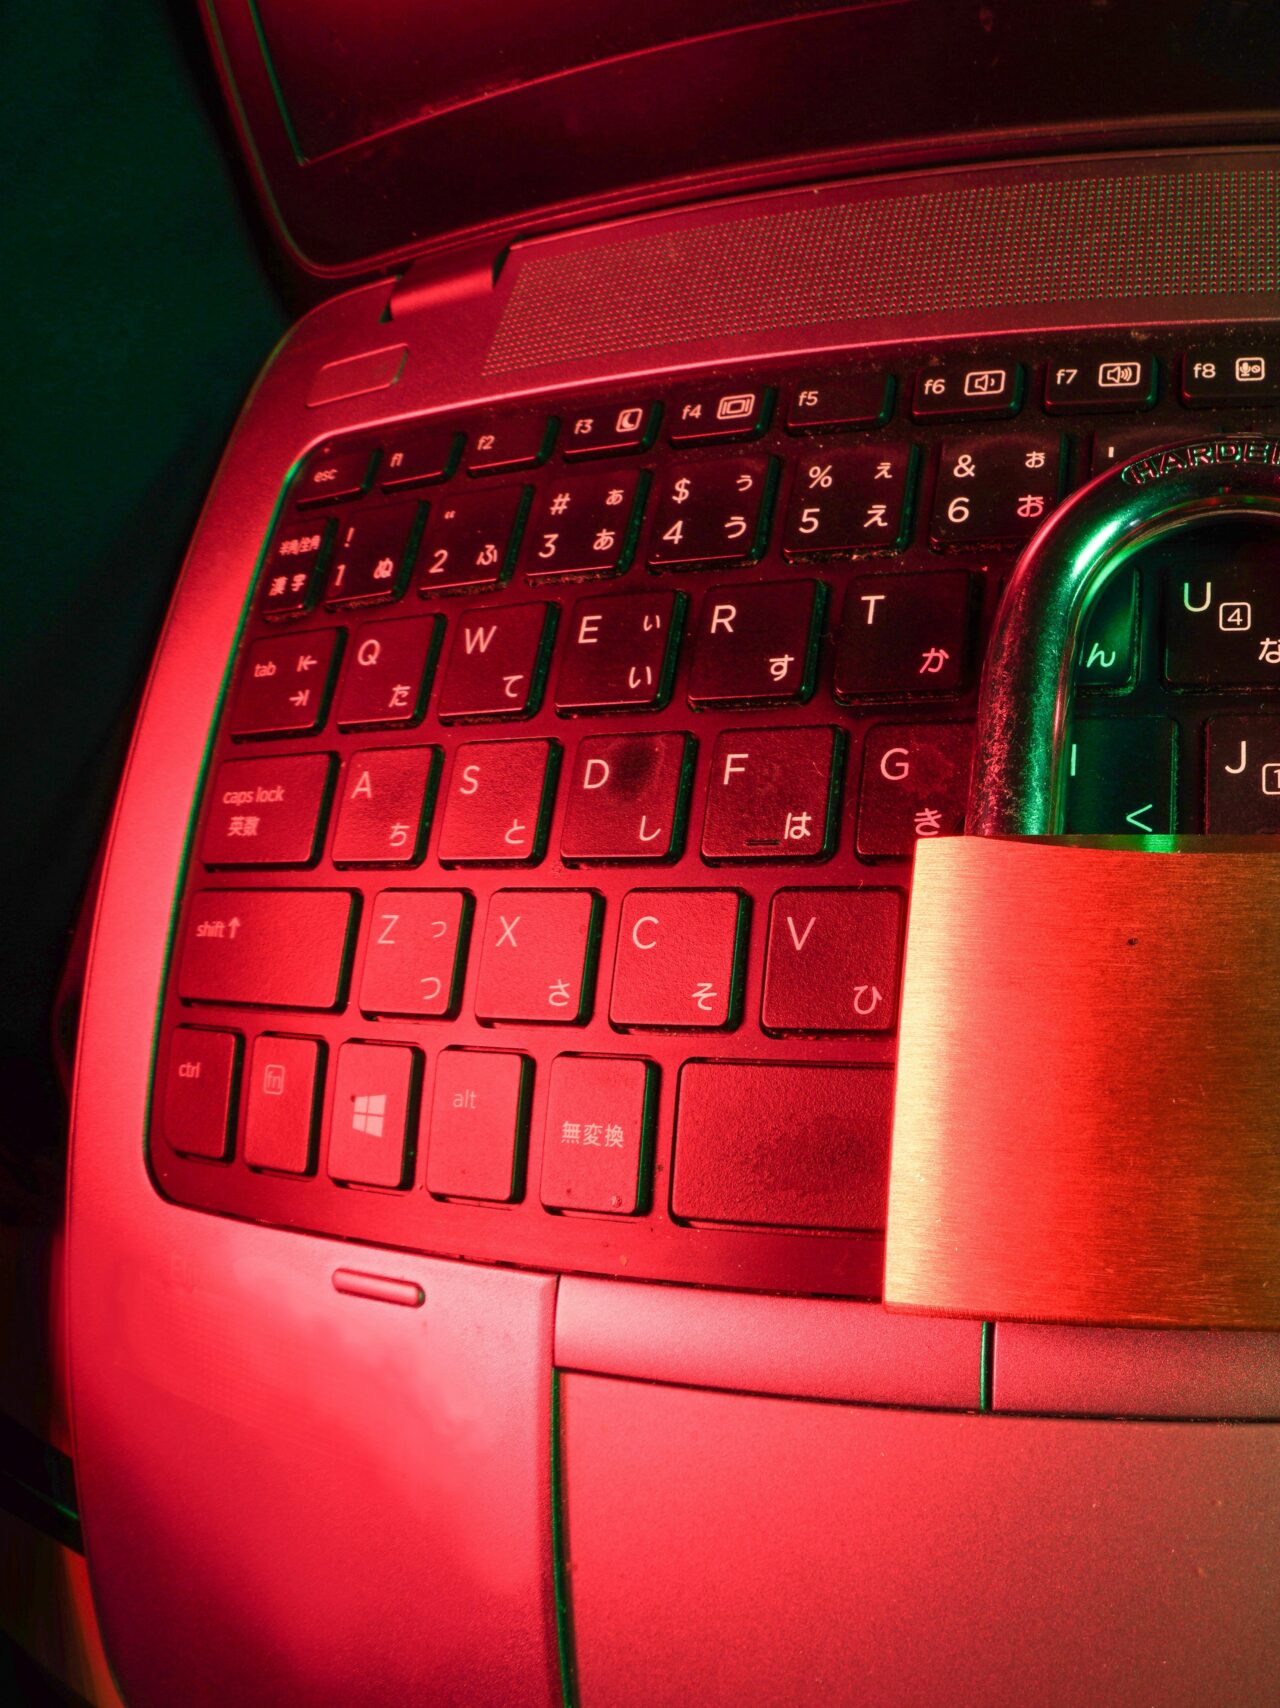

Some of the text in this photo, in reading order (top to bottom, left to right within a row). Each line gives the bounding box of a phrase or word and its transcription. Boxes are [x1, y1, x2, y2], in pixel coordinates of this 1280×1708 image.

[1056, 368, 1078, 385] f7
[1193, 363, 1216, 379] f8
[798, 390, 819, 407] f5
[924, 378, 946, 395] f6
[682, 404, 702, 420] f4
[574, 418, 594, 434] f3
[477, 435, 495, 450] f2
[313, 468, 338, 483] esc
[808, 465, 833, 489] %
[953, 454, 976, 478] &
[672, 477, 691, 504] $
[863, 504, 888, 528] え
[947, 496, 970, 523] 6
[1016, 494, 1045, 518] お
[662, 520, 683, 545] 4
[724, 516, 747, 539] う
[798, 508, 820, 534] 5
[538, 533, 559, 559] 3
[593, 528, 615, 551] あ
[428, 549, 449, 574] 2
[335, 564, 346, 586] 1
[860, 594, 886, 625] T
[1183, 581, 1212, 613] U
[578, 615, 603, 644] E
[710, 604, 737, 634] R
[1227, 607, 1243, 626] 4
[357, 639, 381, 666] Q
[465, 625, 497, 655] W
[254, 661, 277, 678] tab
[769, 654, 795, 682] す
[919, 646, 950, 675] か
[388, 684, 411, 708] た
[503, 674, 524, 698] て
[723, 753, 749, 786] F
[880, 747, 910, 781] G
[1224, 740, 1247, 775] J
[351, 771, 372, 799] A
[459, 765, 480, 795] S
[583, 758, 610, 790] D
[222, 786, 285, 805] caps lock
[227, 815, 260, 837] 英数
[389, 823, 410, 847] ち
[504, 818, 526, 845] と
[784, 811, 812, 840] は
[197, 921, 225, 938] shift
[377, 914, 400, 945] Z
[495, 916, 521, 947] X
[632, 915, 659, 950] C
[786, 916, 816, 951] V
[548, 978, 570, 1007] さ
[691, 982, 717, 1011] そ
[853, 985, 883, 1015] ひ
[178, 1062, 200, 1078] ctrl
[452, 1089, 477, 1109] alt
[560, 1120, 625, 1149] 無変換
